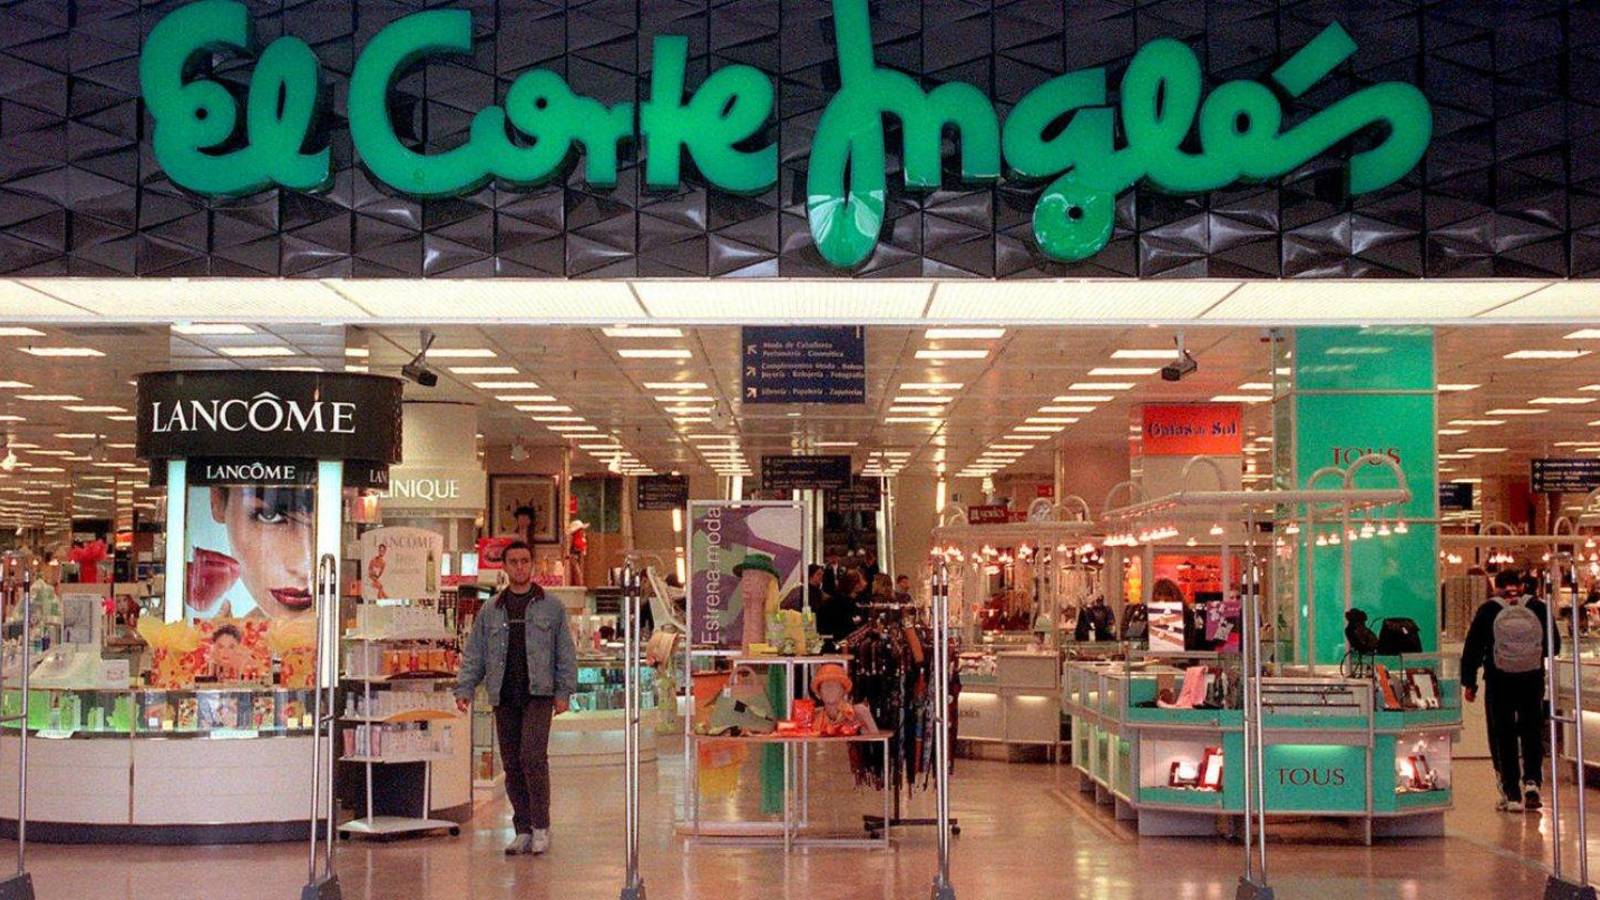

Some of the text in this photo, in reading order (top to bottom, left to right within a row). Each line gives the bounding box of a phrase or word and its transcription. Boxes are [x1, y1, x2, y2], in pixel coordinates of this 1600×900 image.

[141, 0, 1433, 267] El Corte Inglés
[151, 391, 357, 434] LANCÔME
[206, 462, 295, 481] LANCÔME
[1329, 447, 1401, 466] TOUS
[701, 506, 721, 644] Estrena moda
[1277, 767, 1346, 786] TOUS
